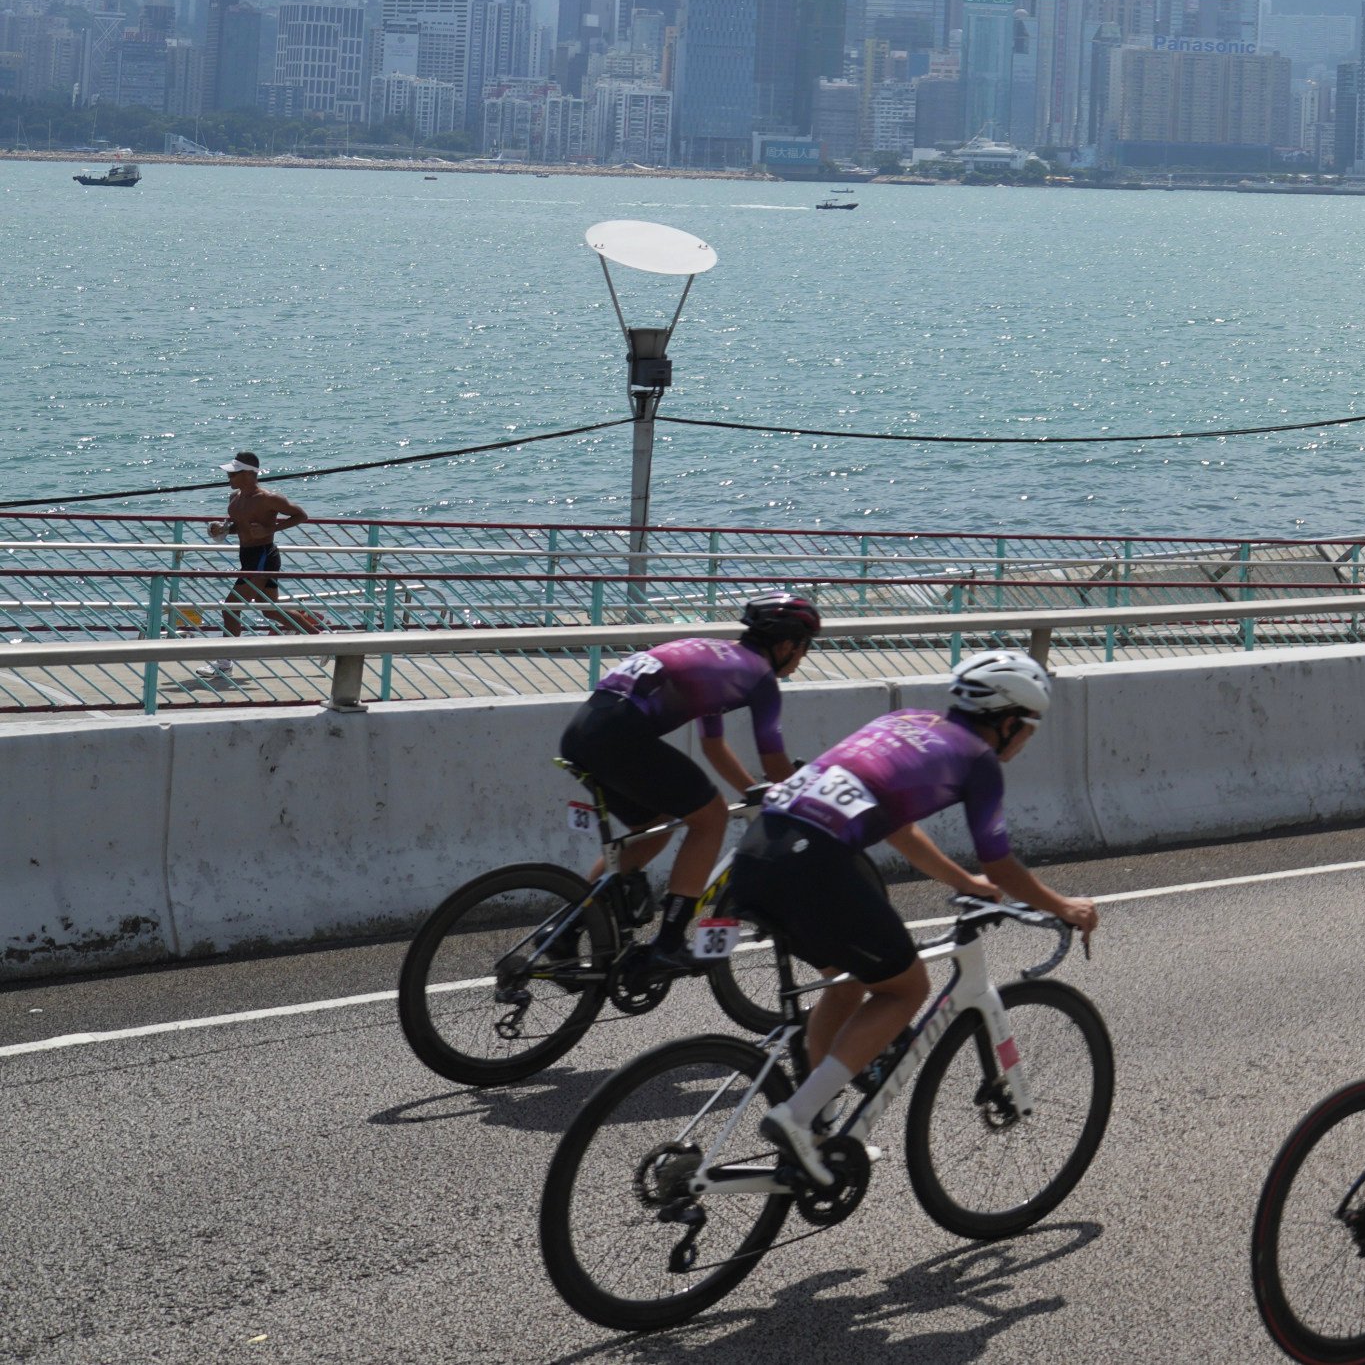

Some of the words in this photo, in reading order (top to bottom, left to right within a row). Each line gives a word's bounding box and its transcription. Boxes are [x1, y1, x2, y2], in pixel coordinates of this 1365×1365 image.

[1154, 36, 1257, 53] Panasonic
[821, 774, 864, 806] 36
[703, 927, 728, 954] 36
